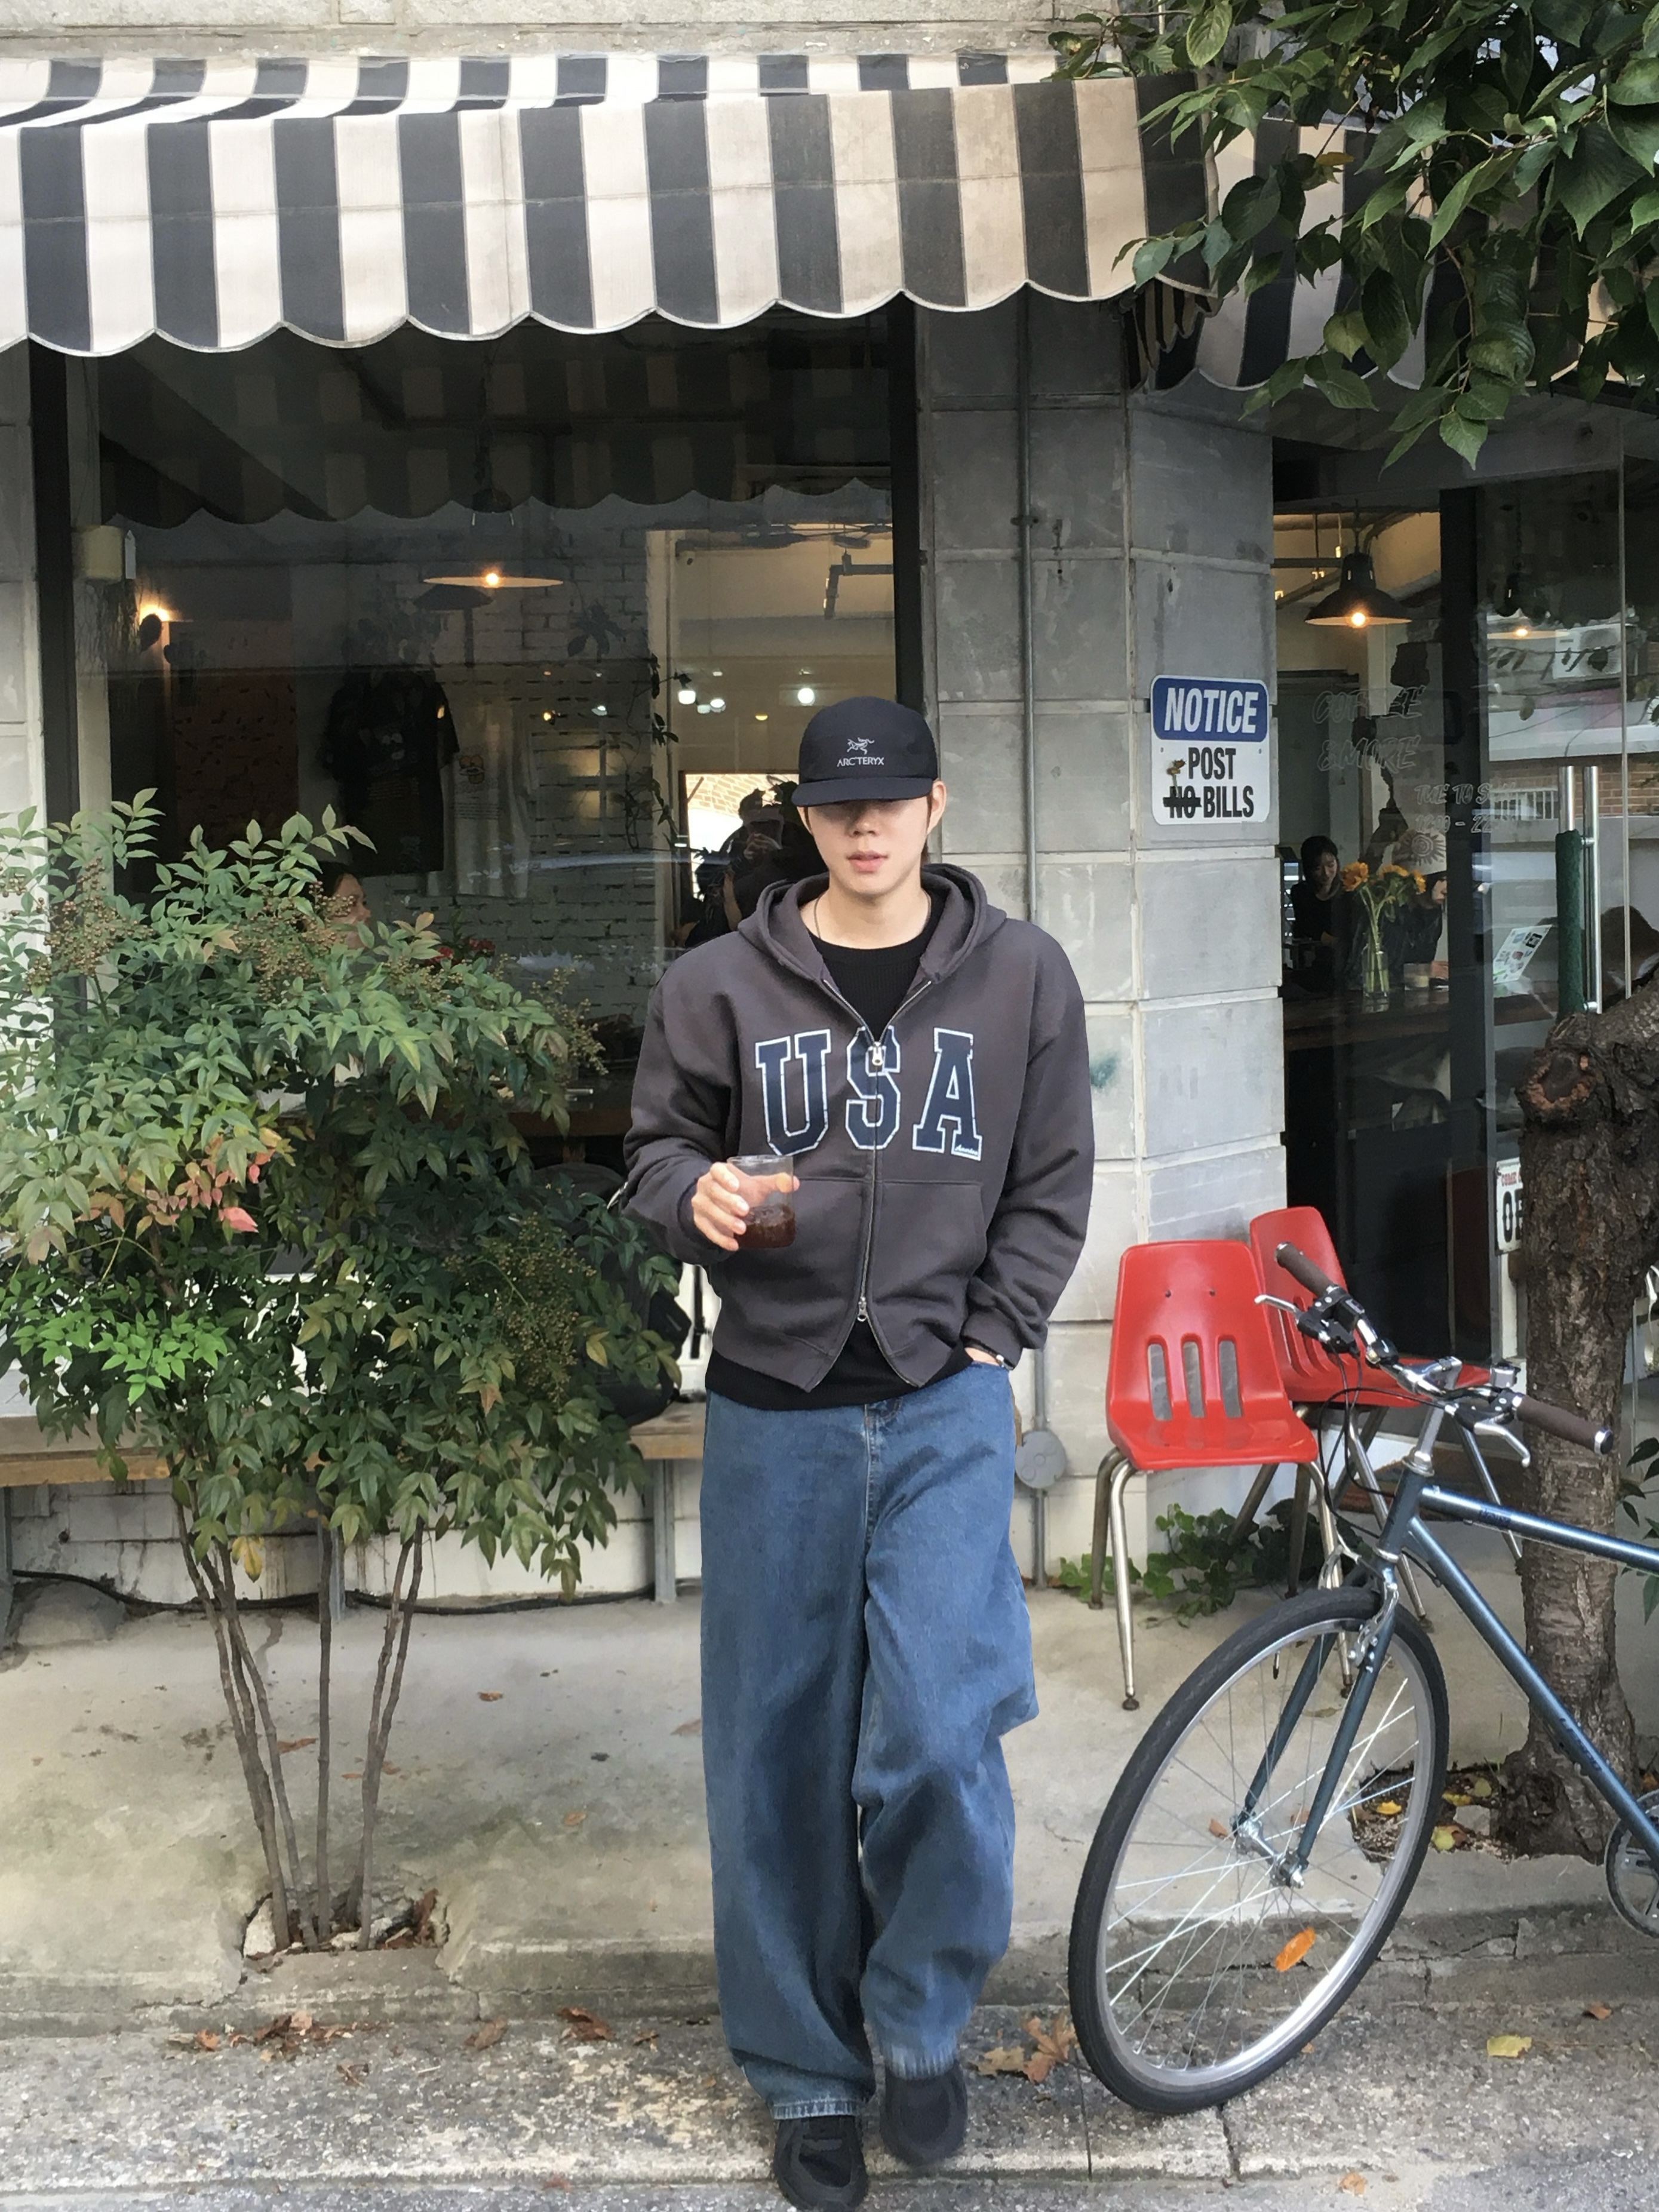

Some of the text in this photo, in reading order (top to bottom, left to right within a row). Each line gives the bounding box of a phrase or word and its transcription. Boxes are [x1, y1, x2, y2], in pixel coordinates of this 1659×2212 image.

[1165, 687, 1259, 733] NOTICE
[1312, 685, 1427, 724] COFEE
[1188, 747, 1236, 780] POST
[1203, 785, 1254, 818] BILLS
[1452, 784, 1474, 804] TO
[755, 1025, 982, 1160] USA
